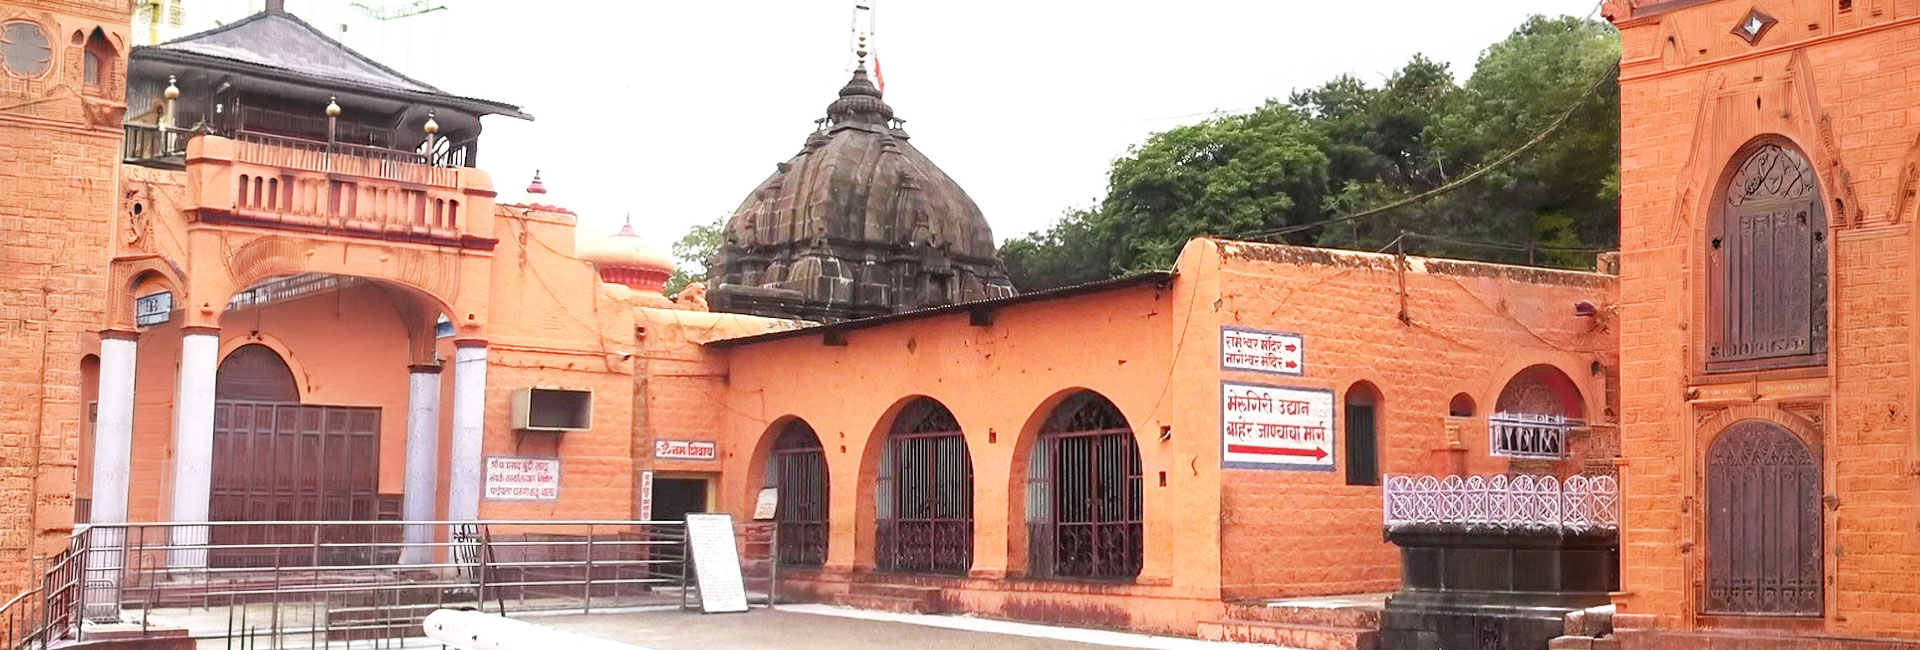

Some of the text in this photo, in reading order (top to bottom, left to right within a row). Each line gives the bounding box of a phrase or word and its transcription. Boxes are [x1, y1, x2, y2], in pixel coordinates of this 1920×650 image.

[1260, 336, 1282, 353] मंदिर
[1261, 353, 1283, 369] मंदिर
[1278, 399, 1310, 416] उद्यान
[1226, 416, 1327, 442] बाहेर जाण्याचा मार्ग
